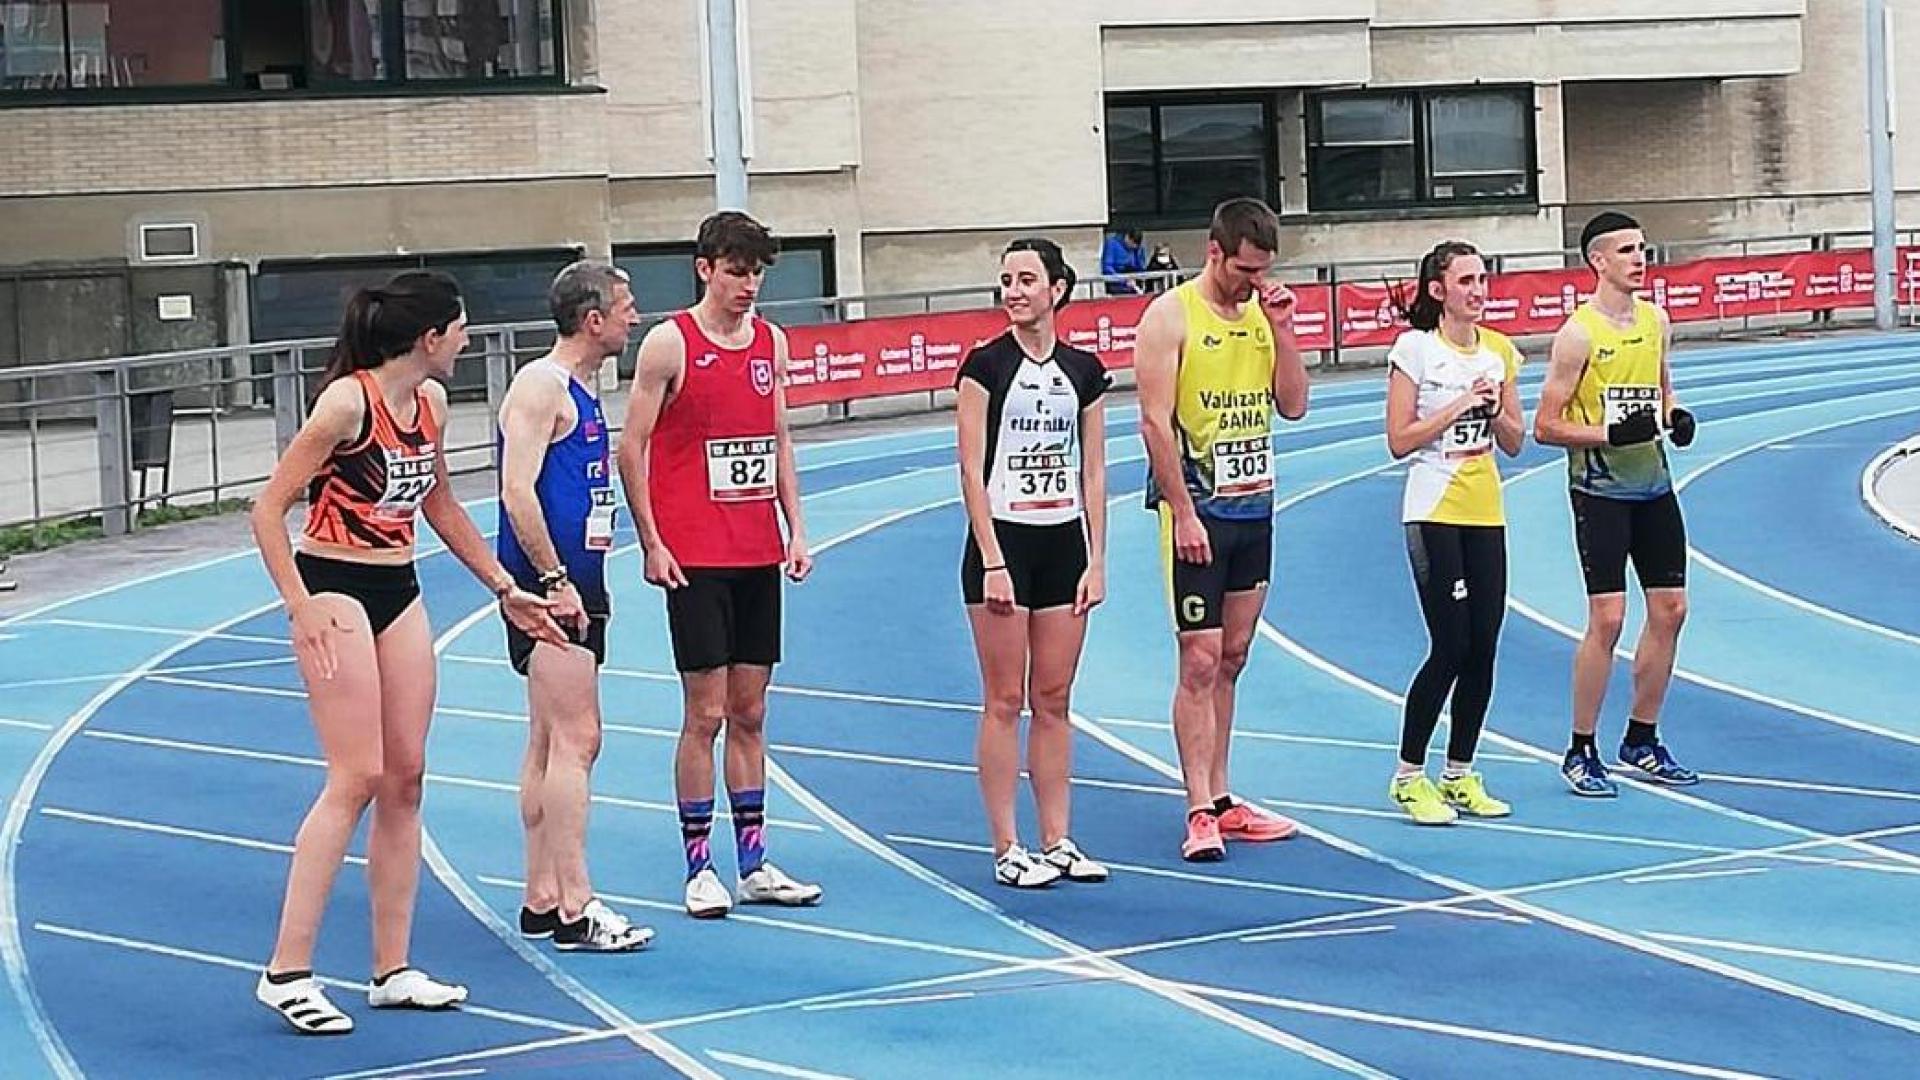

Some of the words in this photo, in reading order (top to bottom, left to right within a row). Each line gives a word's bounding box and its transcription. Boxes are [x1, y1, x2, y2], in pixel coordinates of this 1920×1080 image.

[730, 458, 767, 486] 82
[1226, 454, 1268, 479] 303
[1019, 470, 1067, 494] 376
[1183, 595, 1205, 622] G
